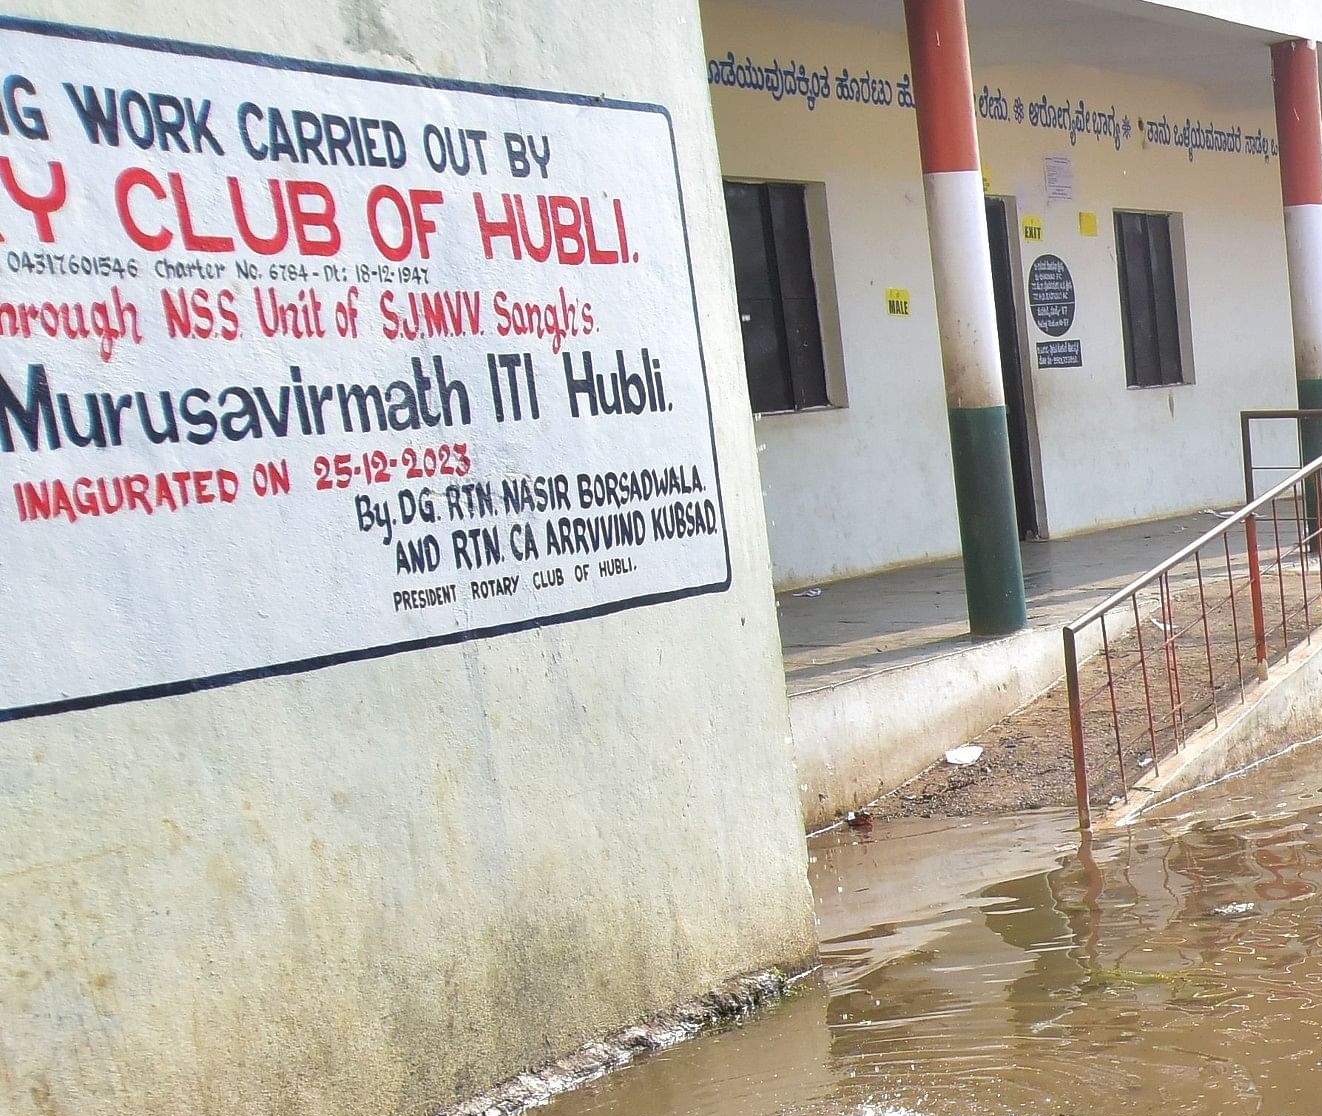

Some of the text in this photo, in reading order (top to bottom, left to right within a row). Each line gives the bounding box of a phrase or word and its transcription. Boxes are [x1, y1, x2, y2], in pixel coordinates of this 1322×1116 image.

[0, 74, 551, 179] G WORK CARRIED OUT BY
[0, 155, 640, 265] Y CLUB OF HUBLI.
[1024, 225, 1041, 240] EXIT
[154, 258, 226, 281] Charter
[236, 259, 261, 281] No.
[253, 286, 325, 339] Unit
[336, 285, 359, 338] of
[888, 299, 909, 315] MALE
[0, 348, 673, 451] Murusavirmath ITI Hubli.
[13, 442, 471, 524] INAGURATED ON 25-12-2023
[501, 474, 569, 514] NASIR
[396, 534, 441, 575] AND
[510, 523, 539, 561] CA
[546, 510, 646, 556] ARRVVIND
[393, 557, 637, 612] PRESIDENT ROTARY CLUB OF HUBLI.
